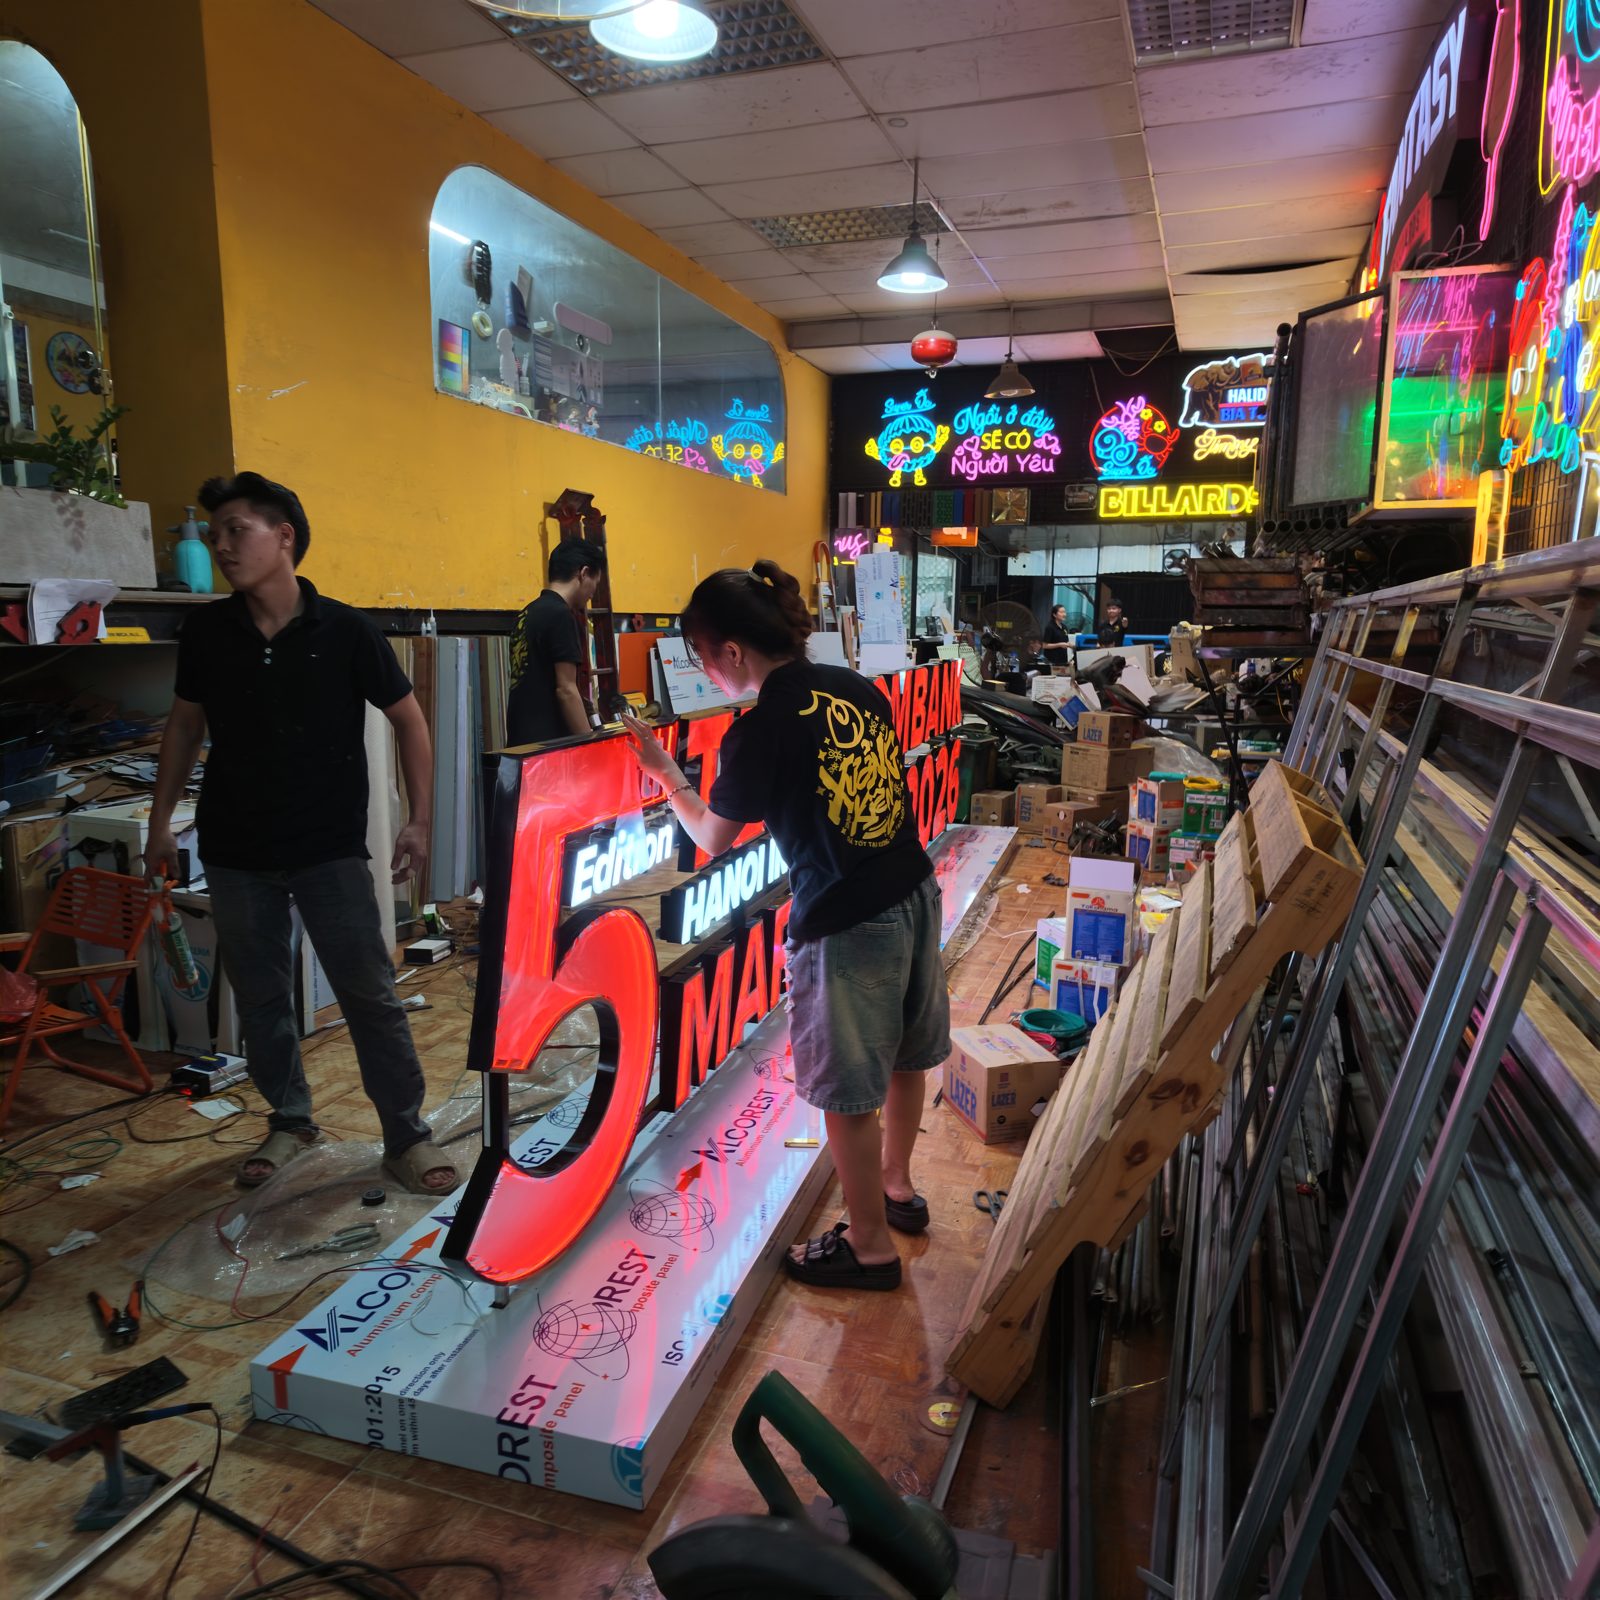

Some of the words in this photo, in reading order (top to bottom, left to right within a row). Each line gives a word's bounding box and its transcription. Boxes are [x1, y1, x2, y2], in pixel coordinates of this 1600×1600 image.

[1020, 406, 1055, 437] đây
[1220, 408, 1246, 422] BIA
[980, 429, 1002, 450] SẼ
[1004, 428, 1031, 450] CÓ
[951, 454, 1009, 480] Người
[1016, 453, 1055, 473] Yêu
[1083, 727, 1103, 741] LAZER
[682, 842, 766, 944] HANOI
[468, 722, 680, 1283] 5
[949, 1070, 977, 1123] LAZER
[691, 1088, 780, 1164] ALCOREST
[656, 1253, 680, 1279] panel
[400, 1366, 431, 1396] direction
[429, 1351, 446, 1366] only
[413, 1379, 432, 1397] days
[430, 1363, 447, 1380] after
[554, 1382, 586, 1418] panel
